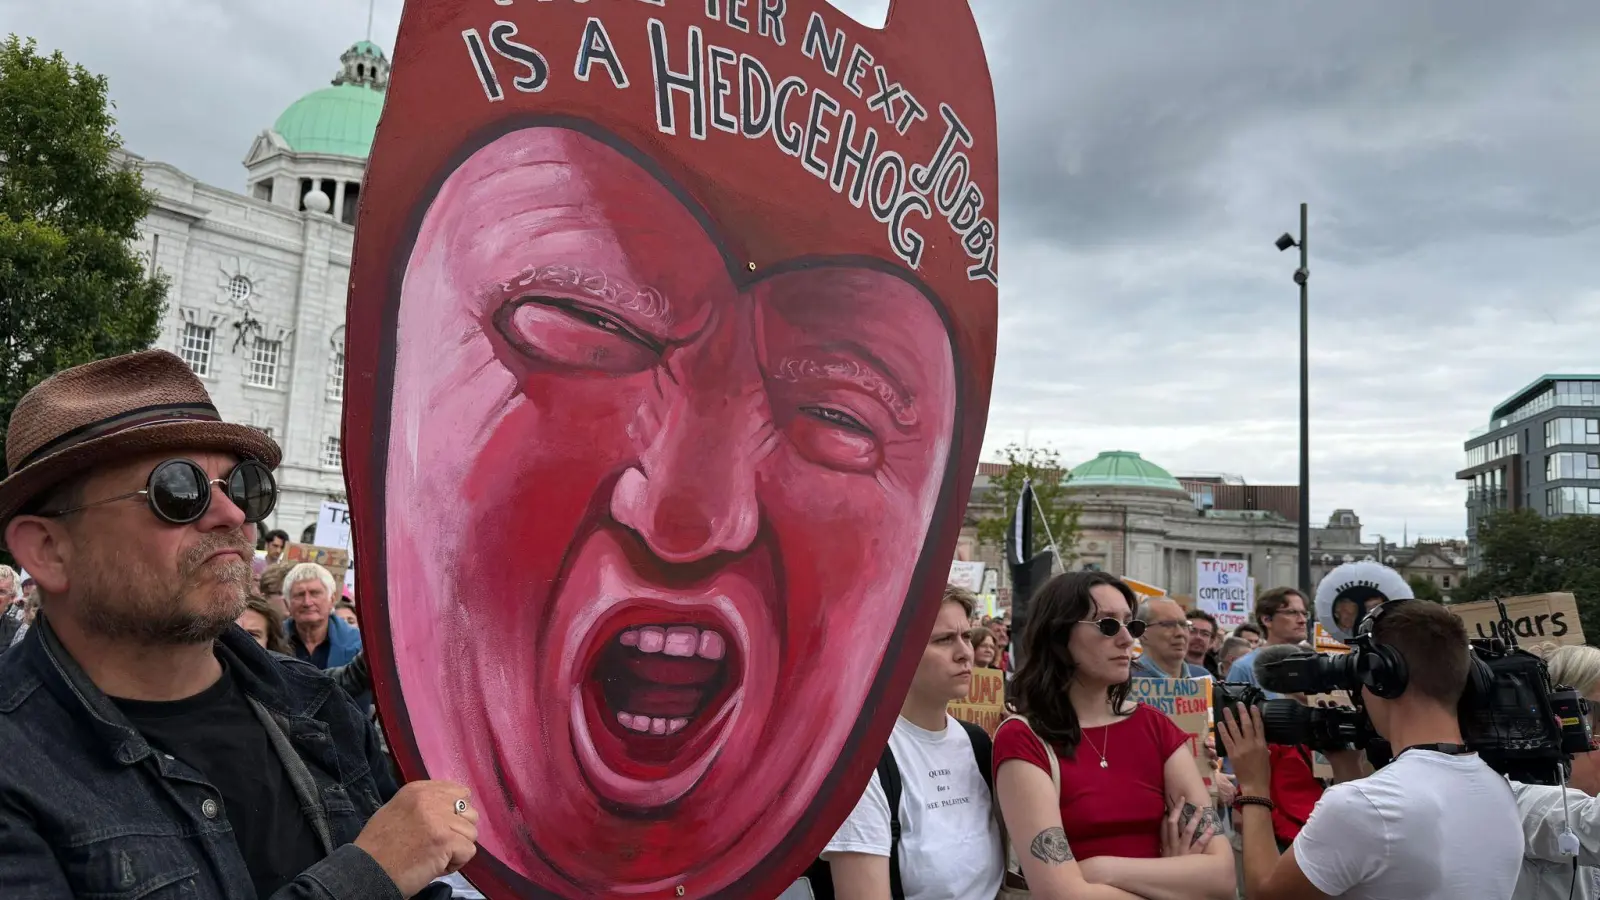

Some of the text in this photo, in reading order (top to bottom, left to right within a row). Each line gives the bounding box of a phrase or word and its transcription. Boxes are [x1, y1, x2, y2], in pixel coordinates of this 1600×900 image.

[462, 17, 932, 269] IS A HEDGEHOG
[801, 11, 928, 135] NEXT
[909, 102, 999, 288] JOBBY
[963, 674, 1003, 705] UMP
[1131, 679, 1199, 696] COTLAND
[926, 801, 940, 809] REE
